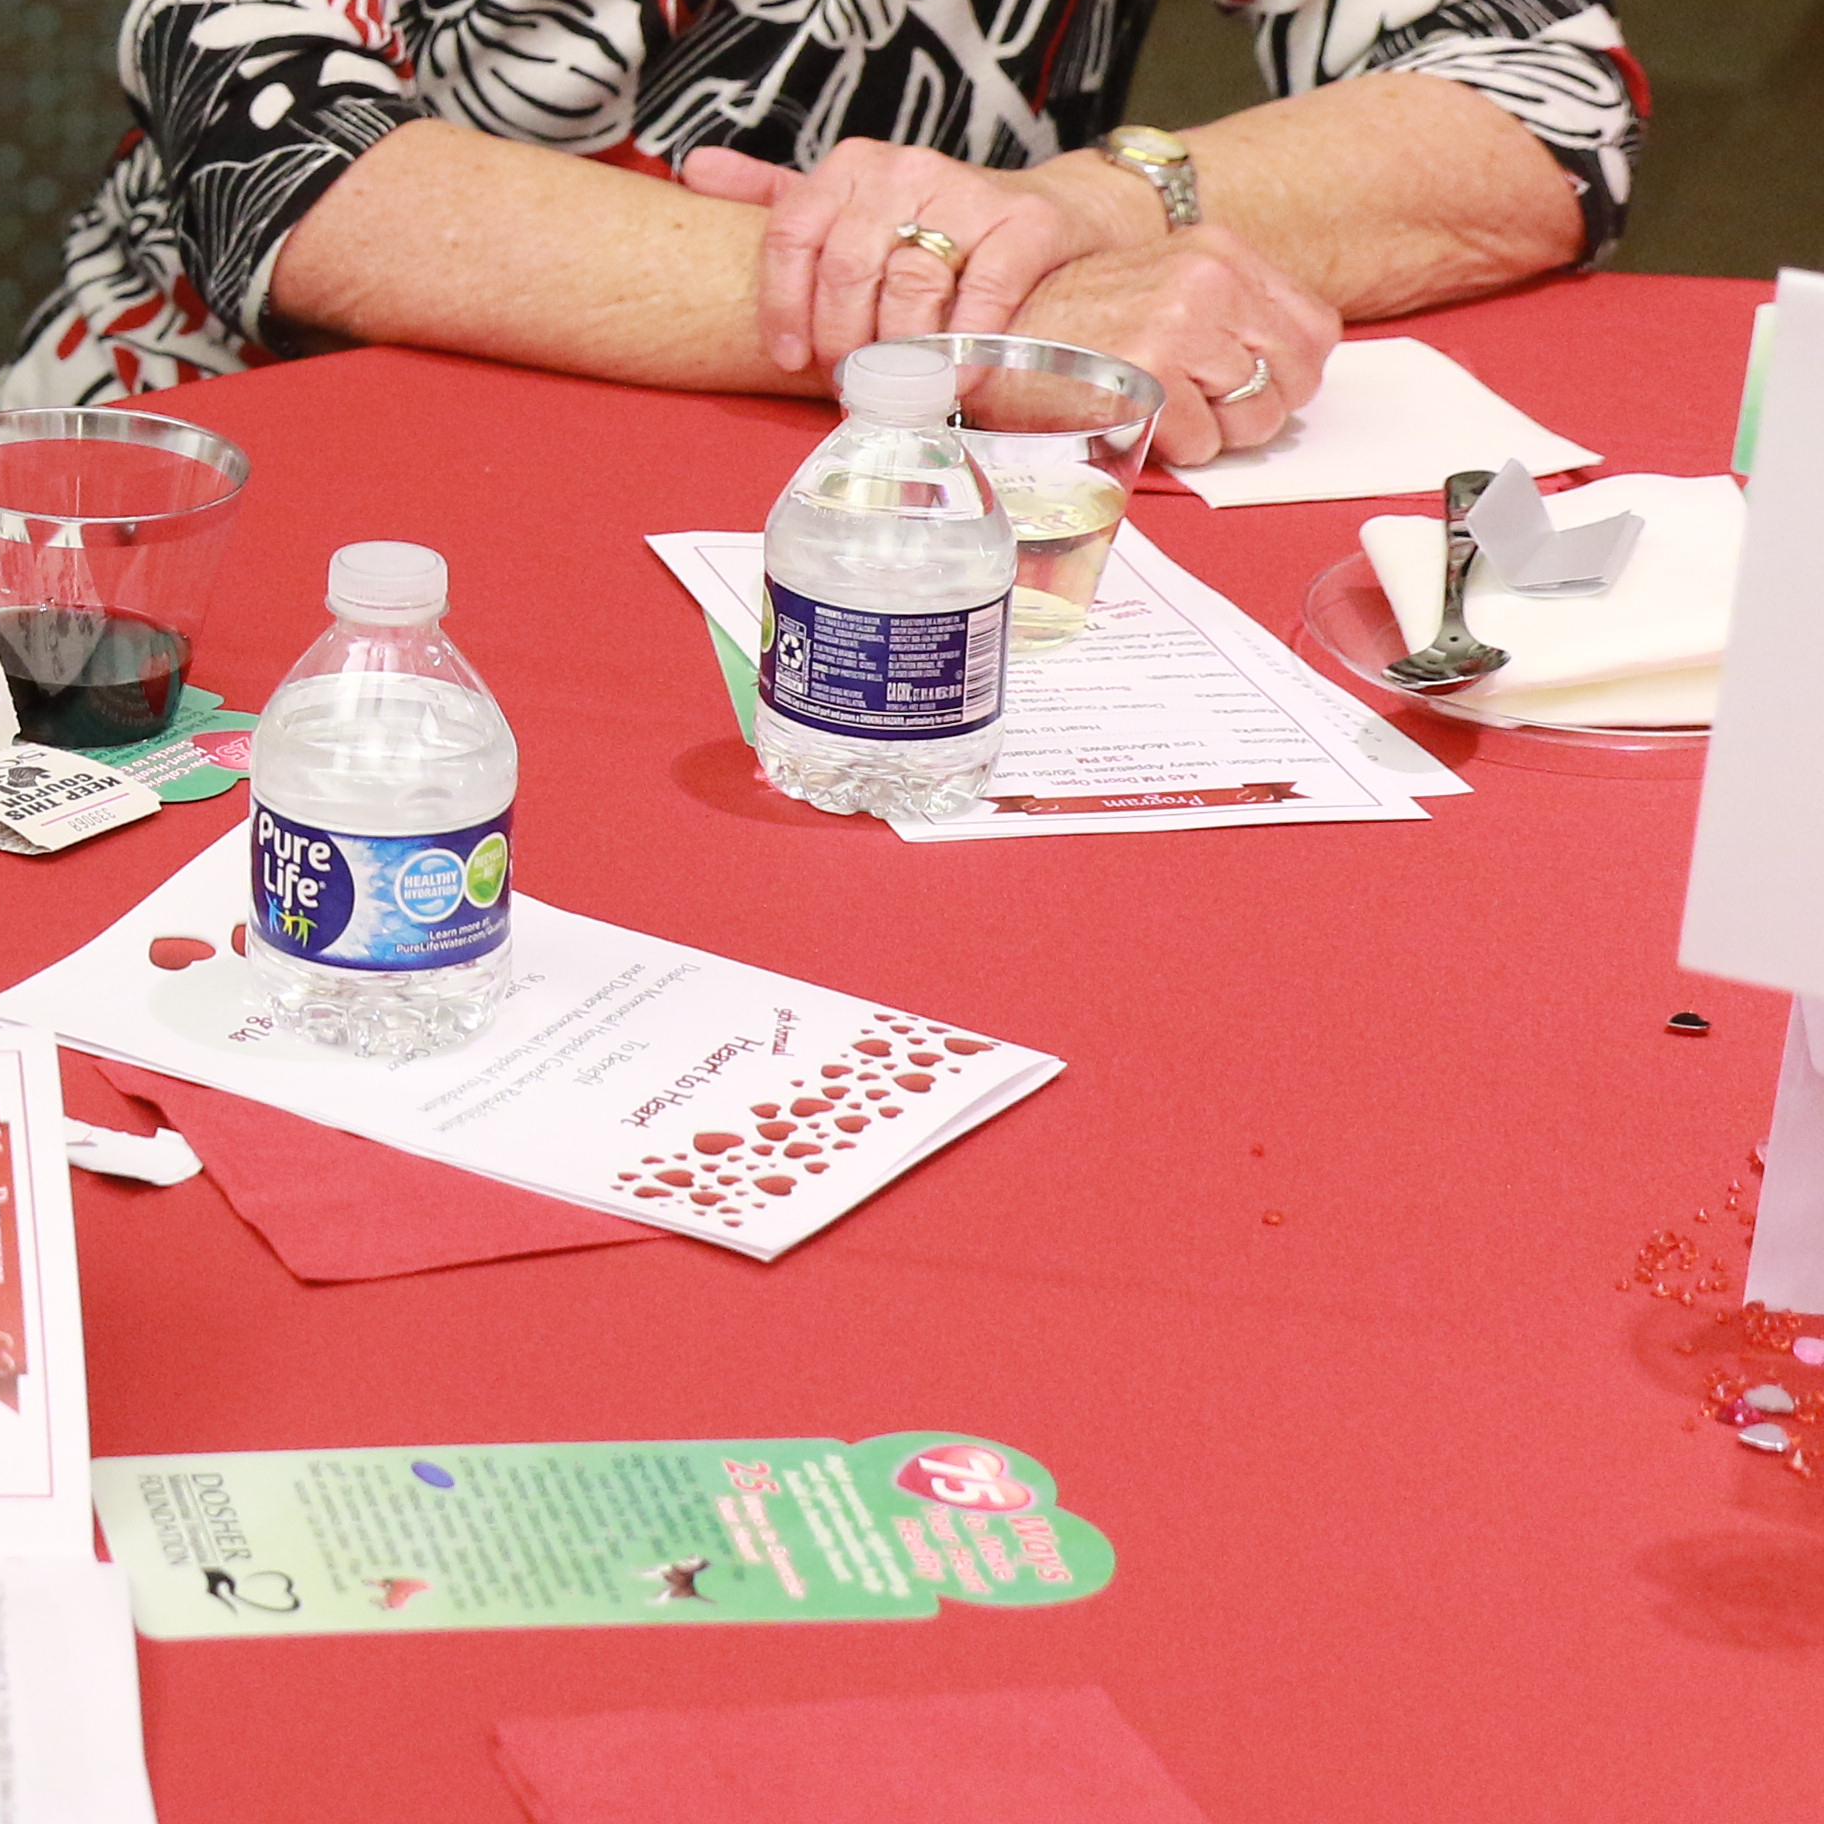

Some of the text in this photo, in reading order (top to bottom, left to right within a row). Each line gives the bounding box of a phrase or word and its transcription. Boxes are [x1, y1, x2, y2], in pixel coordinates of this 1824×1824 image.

[1026, 705, 1107, 715] Foundation
[1060, 723, 1102, 733] Heart
[1032, 768, 1075, 778] 50/50
[1075, 757, 1101, 765] PM
[1169, 758, 1219, 769] Heavy
[0, 773, 94, 808] COUPON
[1050, 773, 1198, 788] 4:45 PM Doors Open
[4, 776, 122, 821] KEEP THIS
[1101, 793, 1205, 810] Program
[258, 811, 332, 872] Pure
[263, 852, 319, 909] Life
[404, 871, 458, 887] HEALTHY
[404, 885, 458, 899] HYDRATION
[429, 927, 457, 941] Learn
[458, 920, 481, 936] more
[618, 964, 646, 983] and
[654, 963, 701, 989] Dosher
[583, 979, 630, 1009] Dosher
[600, 988, 663, 1028] Memorial
[531, 1008, 591, 1050] Memorial
[559, 1024, 612, 1061] Hospital
[479, 1043, 536, 1079] Hospital
[511, 1056, 564, 1088] Cardiac
[572, 1040, 650, 1087] To Benefit
[620, 1036, 766, 1128] Heart to Heart
[723, 1459, 781, 1493] 25
[918, 1457, 1006, 1504] 75
[138, 1475, 190, 1565] FOUNDATION
[192, 1473, 254, 1563] DOSHER
[893, 1516, 946, 1581] Healthy
[961, 1514, 1017, 1582] to Make
[1005, 1516, 1073, 1584] Ways
[946, 1547, 992, 1595] Heart
